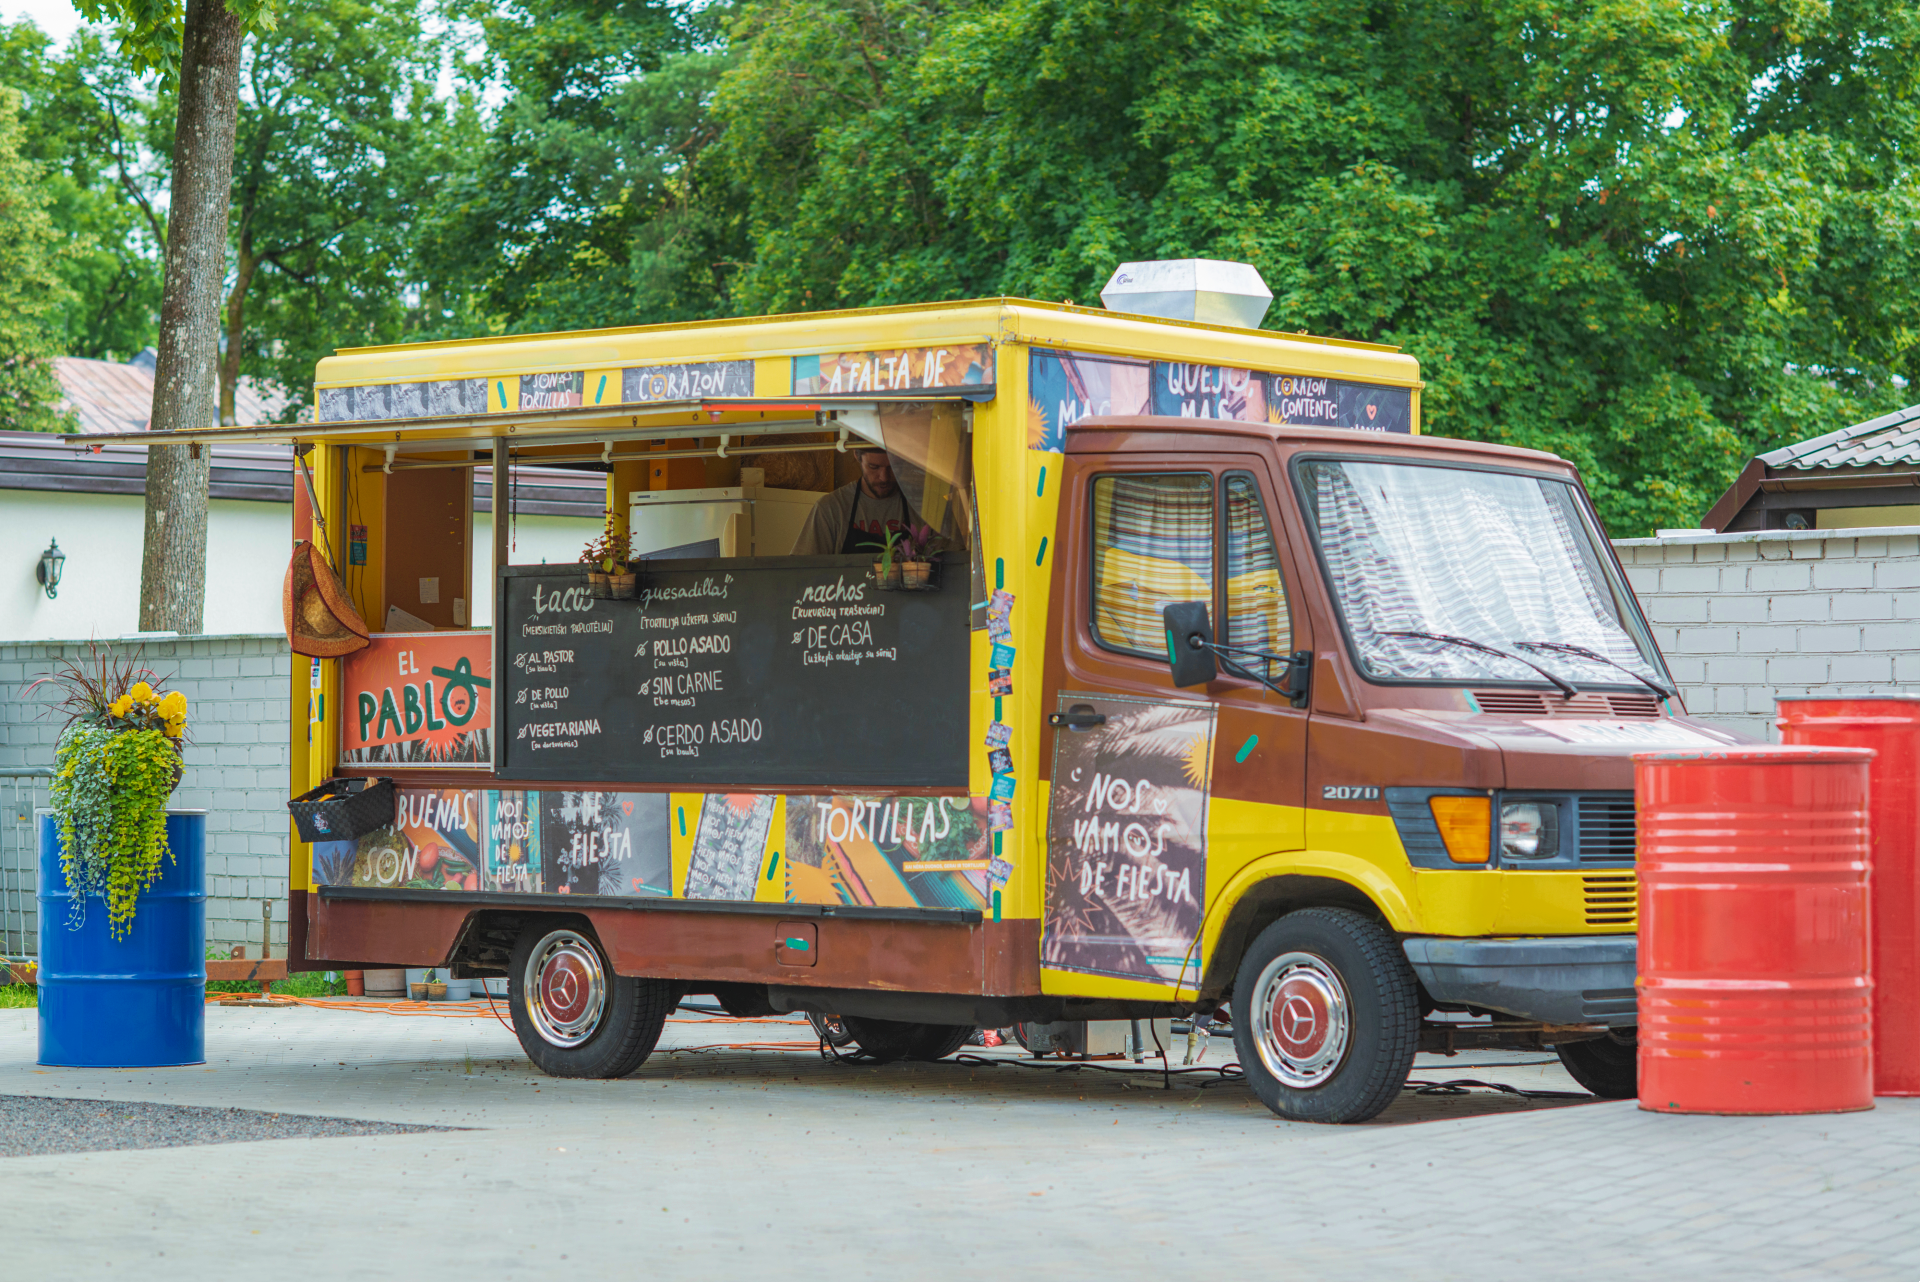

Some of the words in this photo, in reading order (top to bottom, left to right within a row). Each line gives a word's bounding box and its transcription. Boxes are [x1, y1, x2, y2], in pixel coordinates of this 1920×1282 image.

[533, 373, 558, 389] SON
[638, 366, 727, 400] CORAZON
[829, 374, 843, 395] A
[848, 353, 911, 393] FALTA
[923, 350, 948, 389] DE
[1275, 376, 1328, 397] CORAZON
[521, 389, 572, 409] TORTILLAS
[532, 584, 595, 615] tacos
[640, 576, 728, 611] quesadillas
[802, 575, 866, 603] nachos
[654, 637, 687, 657] POLLO
[689, 635, 731, 654] ASADO
[808, 626, 828, 649] DE
[830, 620, 873, 646] CASA
[398, 650, 420, 676] EL
[528, 653, 541, 664] AL
[543, 650, 574, 665] PASTOR
[531, 689, 542, 701] DE
[545, 687, 569, 699] POLLO
[653, 676, 673, 696] SIN
[678, 670, 724, 694] CARNE
[358, 678, 479, 742] PABLO
[529, 719, 602, 738] VEGETARIANA
[656, 723, 704, 746] CERDO
[709, 718, 762, 744] ASADO
[1085, 773, 1151, 813] NOS
[398, 792, 474, 832] BUENAS
[495, 800, 522, 818] NOS
[582, 792, 603, 825] DE
[817, 796, 954, 843] TORTILLAS
[491, 820, 533, 840] VAMOS
[1074, 816, 1171, 857] VAMOS
[495, 847, 507, 861] DE
[573, 827, 633, 867] FIESTA
[363, 845, 418, 884] SON
[496, 863, 528, 883] FIESTA
[1079, 861, 1106, 895] DE
[1116, 863, 1191, 903] FIESTA
